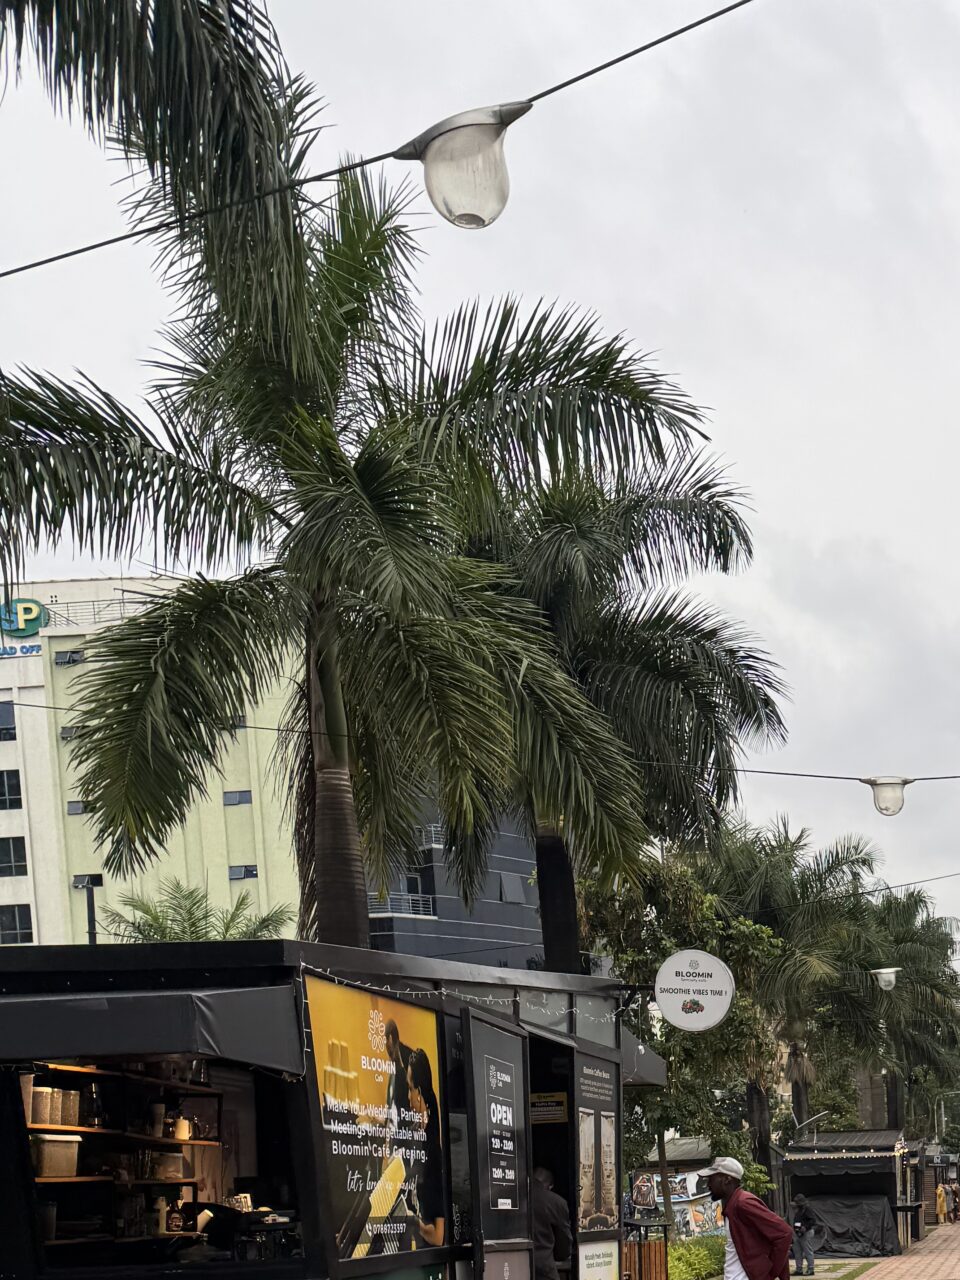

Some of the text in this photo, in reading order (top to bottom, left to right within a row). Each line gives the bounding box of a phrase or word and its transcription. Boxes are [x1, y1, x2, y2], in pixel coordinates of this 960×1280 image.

[659, 987, 691, 995] SMOOTHIE
[692, 988, 709, 996] VIBES
[328, 1099, 348, 1114] Make
[350, 1099, 366, 1116] Your
[400, 1107, 423, 1122] Parties
[491, 1102, 513, 1127] OPEN
[330, 1119, 427, 1142] Meetings Unforgettable with
